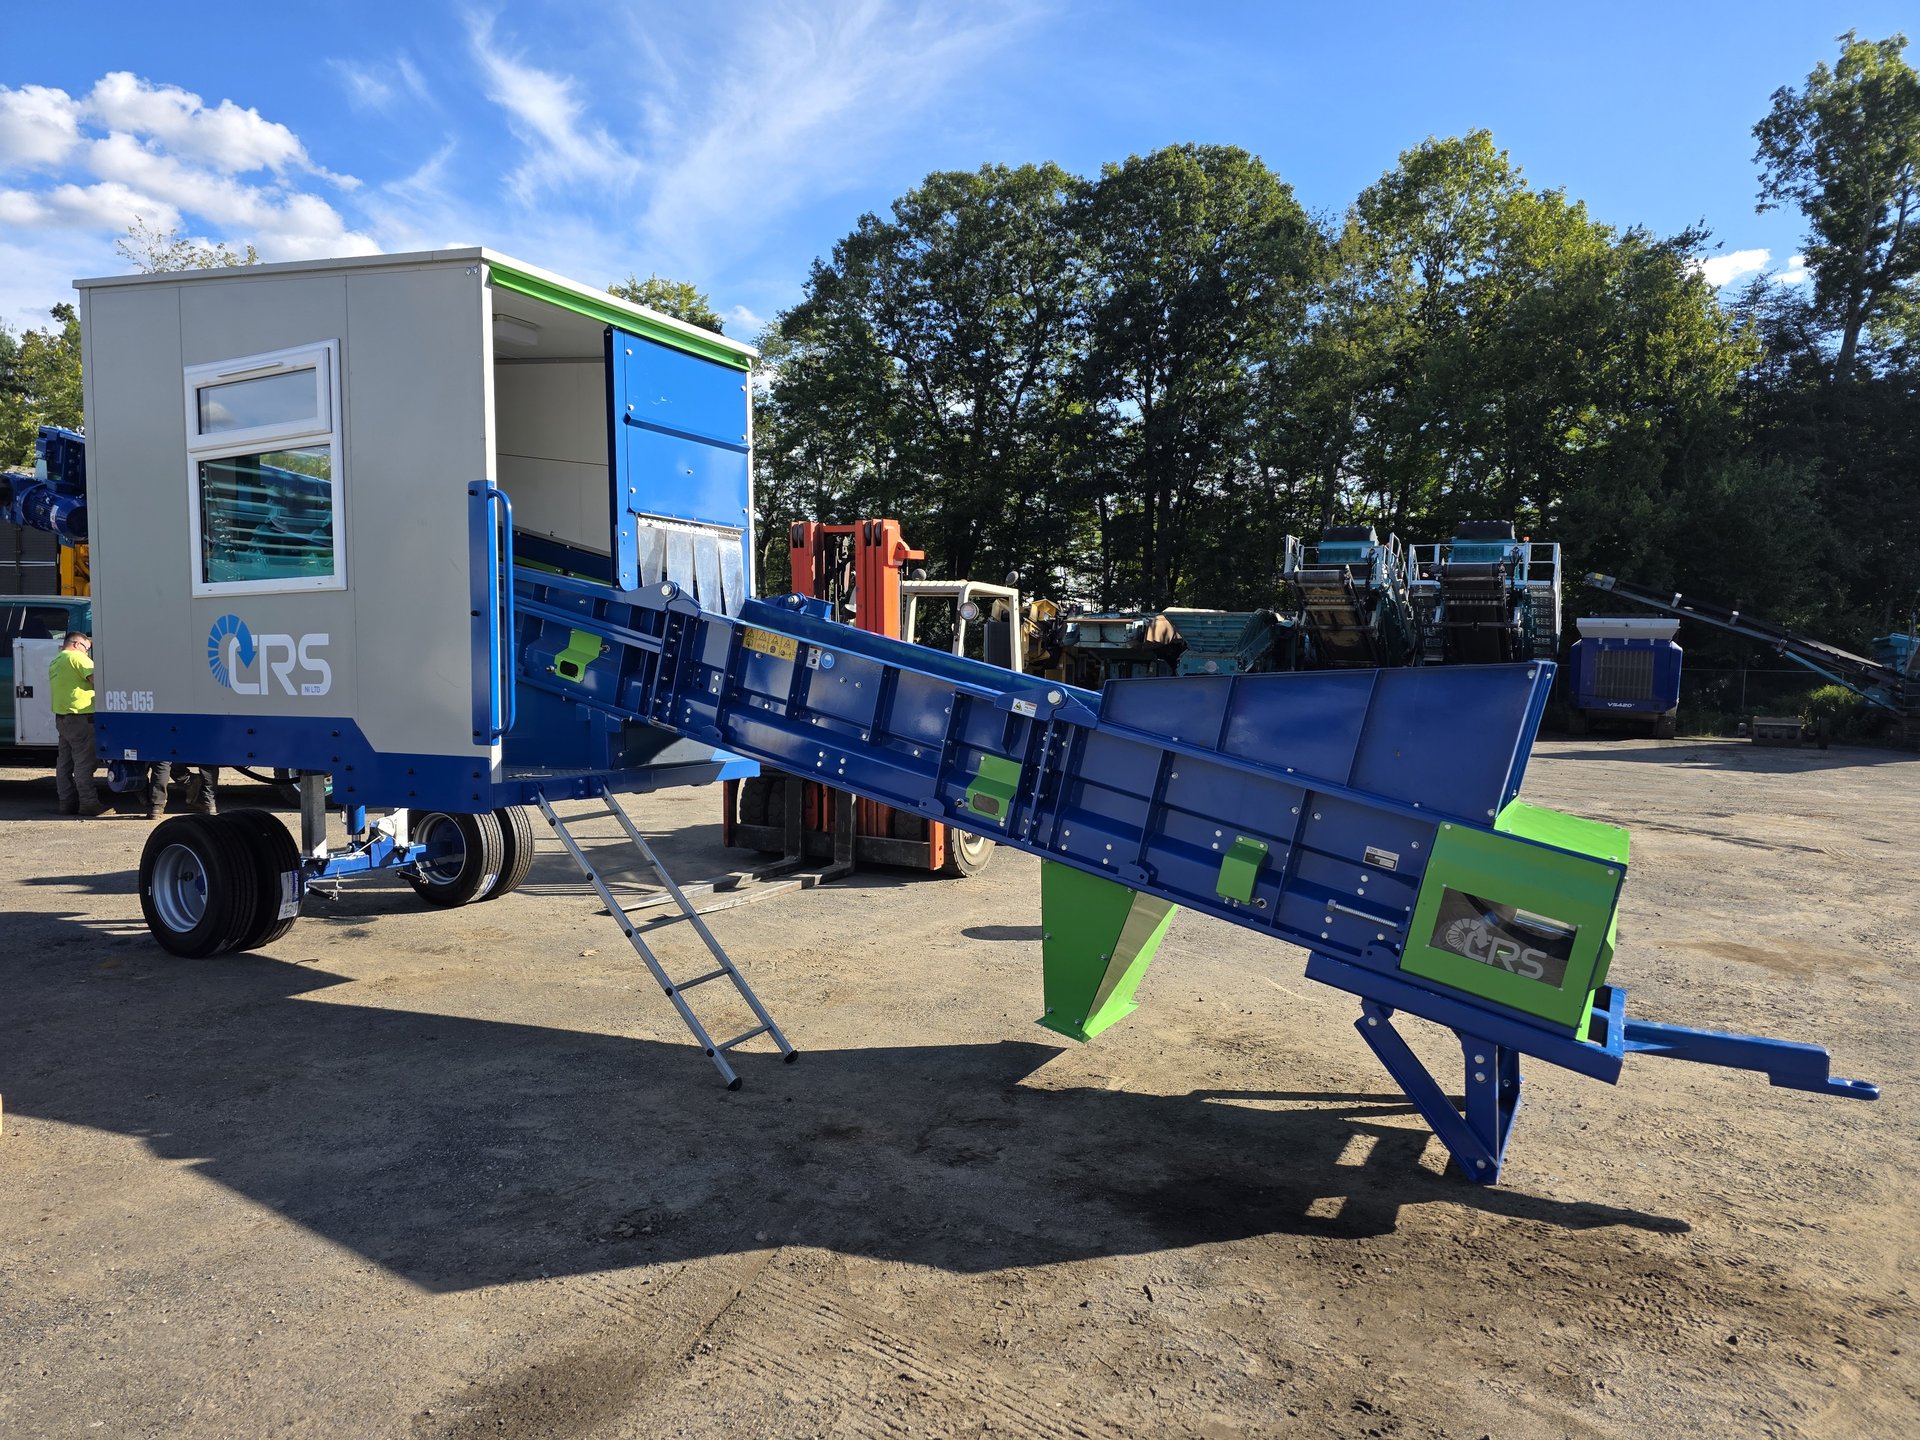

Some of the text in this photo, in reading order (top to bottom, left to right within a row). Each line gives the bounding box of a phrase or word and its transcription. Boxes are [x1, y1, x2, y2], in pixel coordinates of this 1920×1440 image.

[228, 633, 332, 696] CRS
[105, 690, 154, 711] CRS-055
[1463, 931, 1548, 980] CRS
